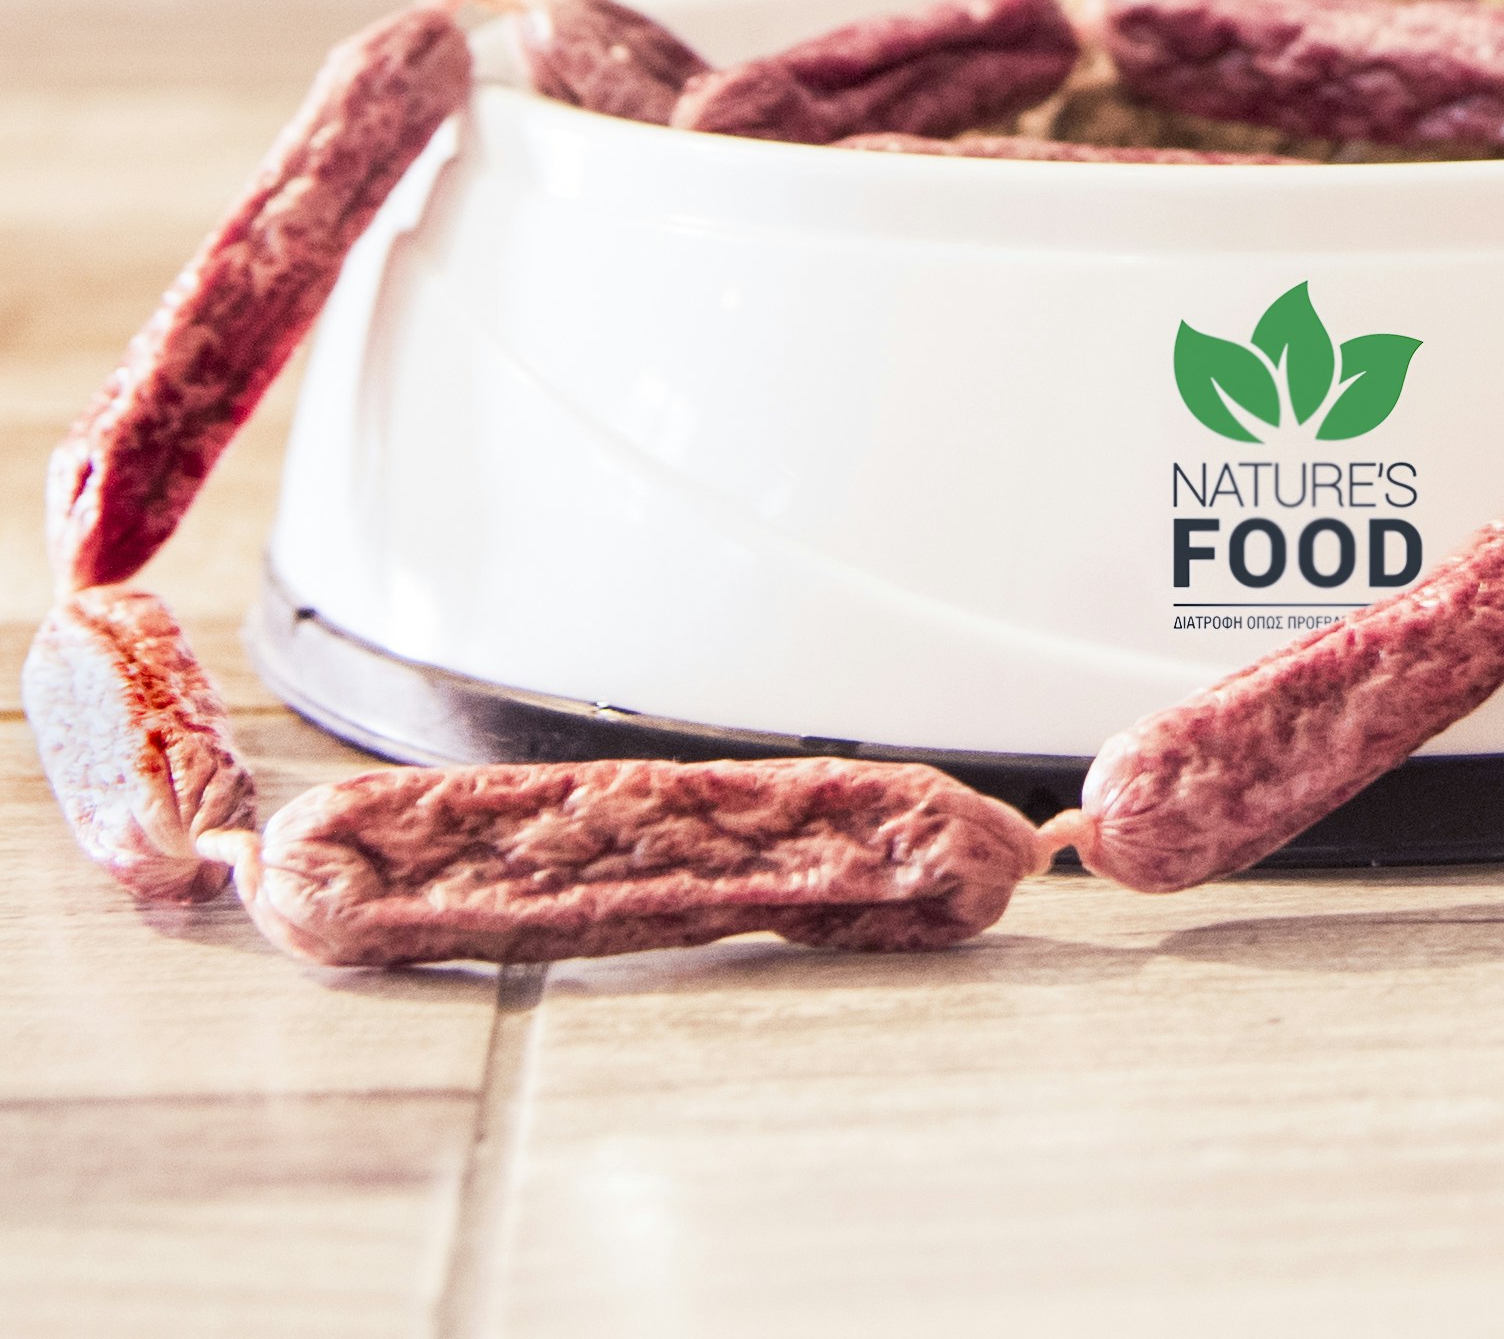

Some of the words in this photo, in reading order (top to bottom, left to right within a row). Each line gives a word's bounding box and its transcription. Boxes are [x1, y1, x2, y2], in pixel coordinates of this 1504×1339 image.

[1173, 462, 1418, 508] NATURE'S
[1173, 517, 1423, 588] FOOD
[1173, 615, 1243, 630] ΔΙΑΤΡΟΦΗ
[1247, 615, 1284, 630] ΟΠΩΣ
